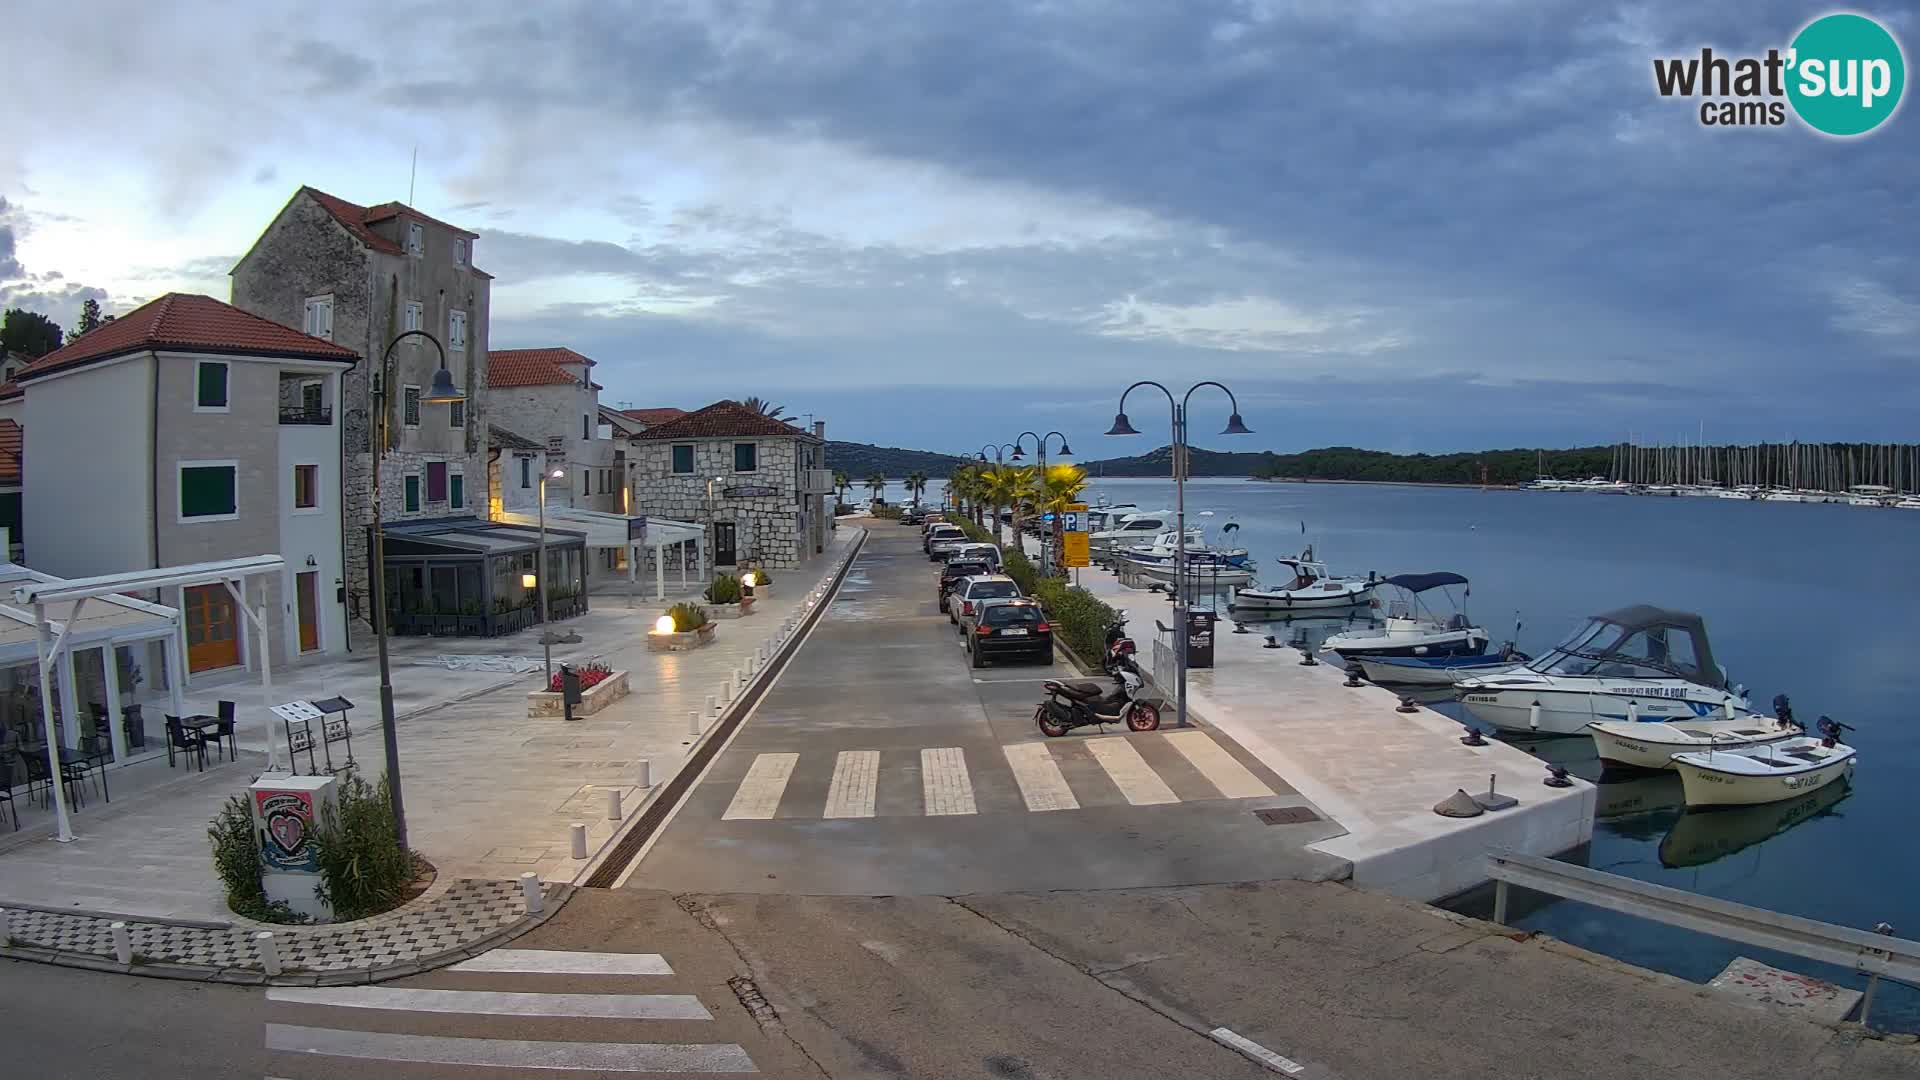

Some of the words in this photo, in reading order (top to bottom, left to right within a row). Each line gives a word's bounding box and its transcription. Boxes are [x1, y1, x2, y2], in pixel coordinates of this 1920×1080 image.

[1065, 514, 1076, 530] P
[1645, 687, 1664, 697] RENT
[1664, 688, 1670, 697] A
[1670, 688, 1688, 698] BOAT
